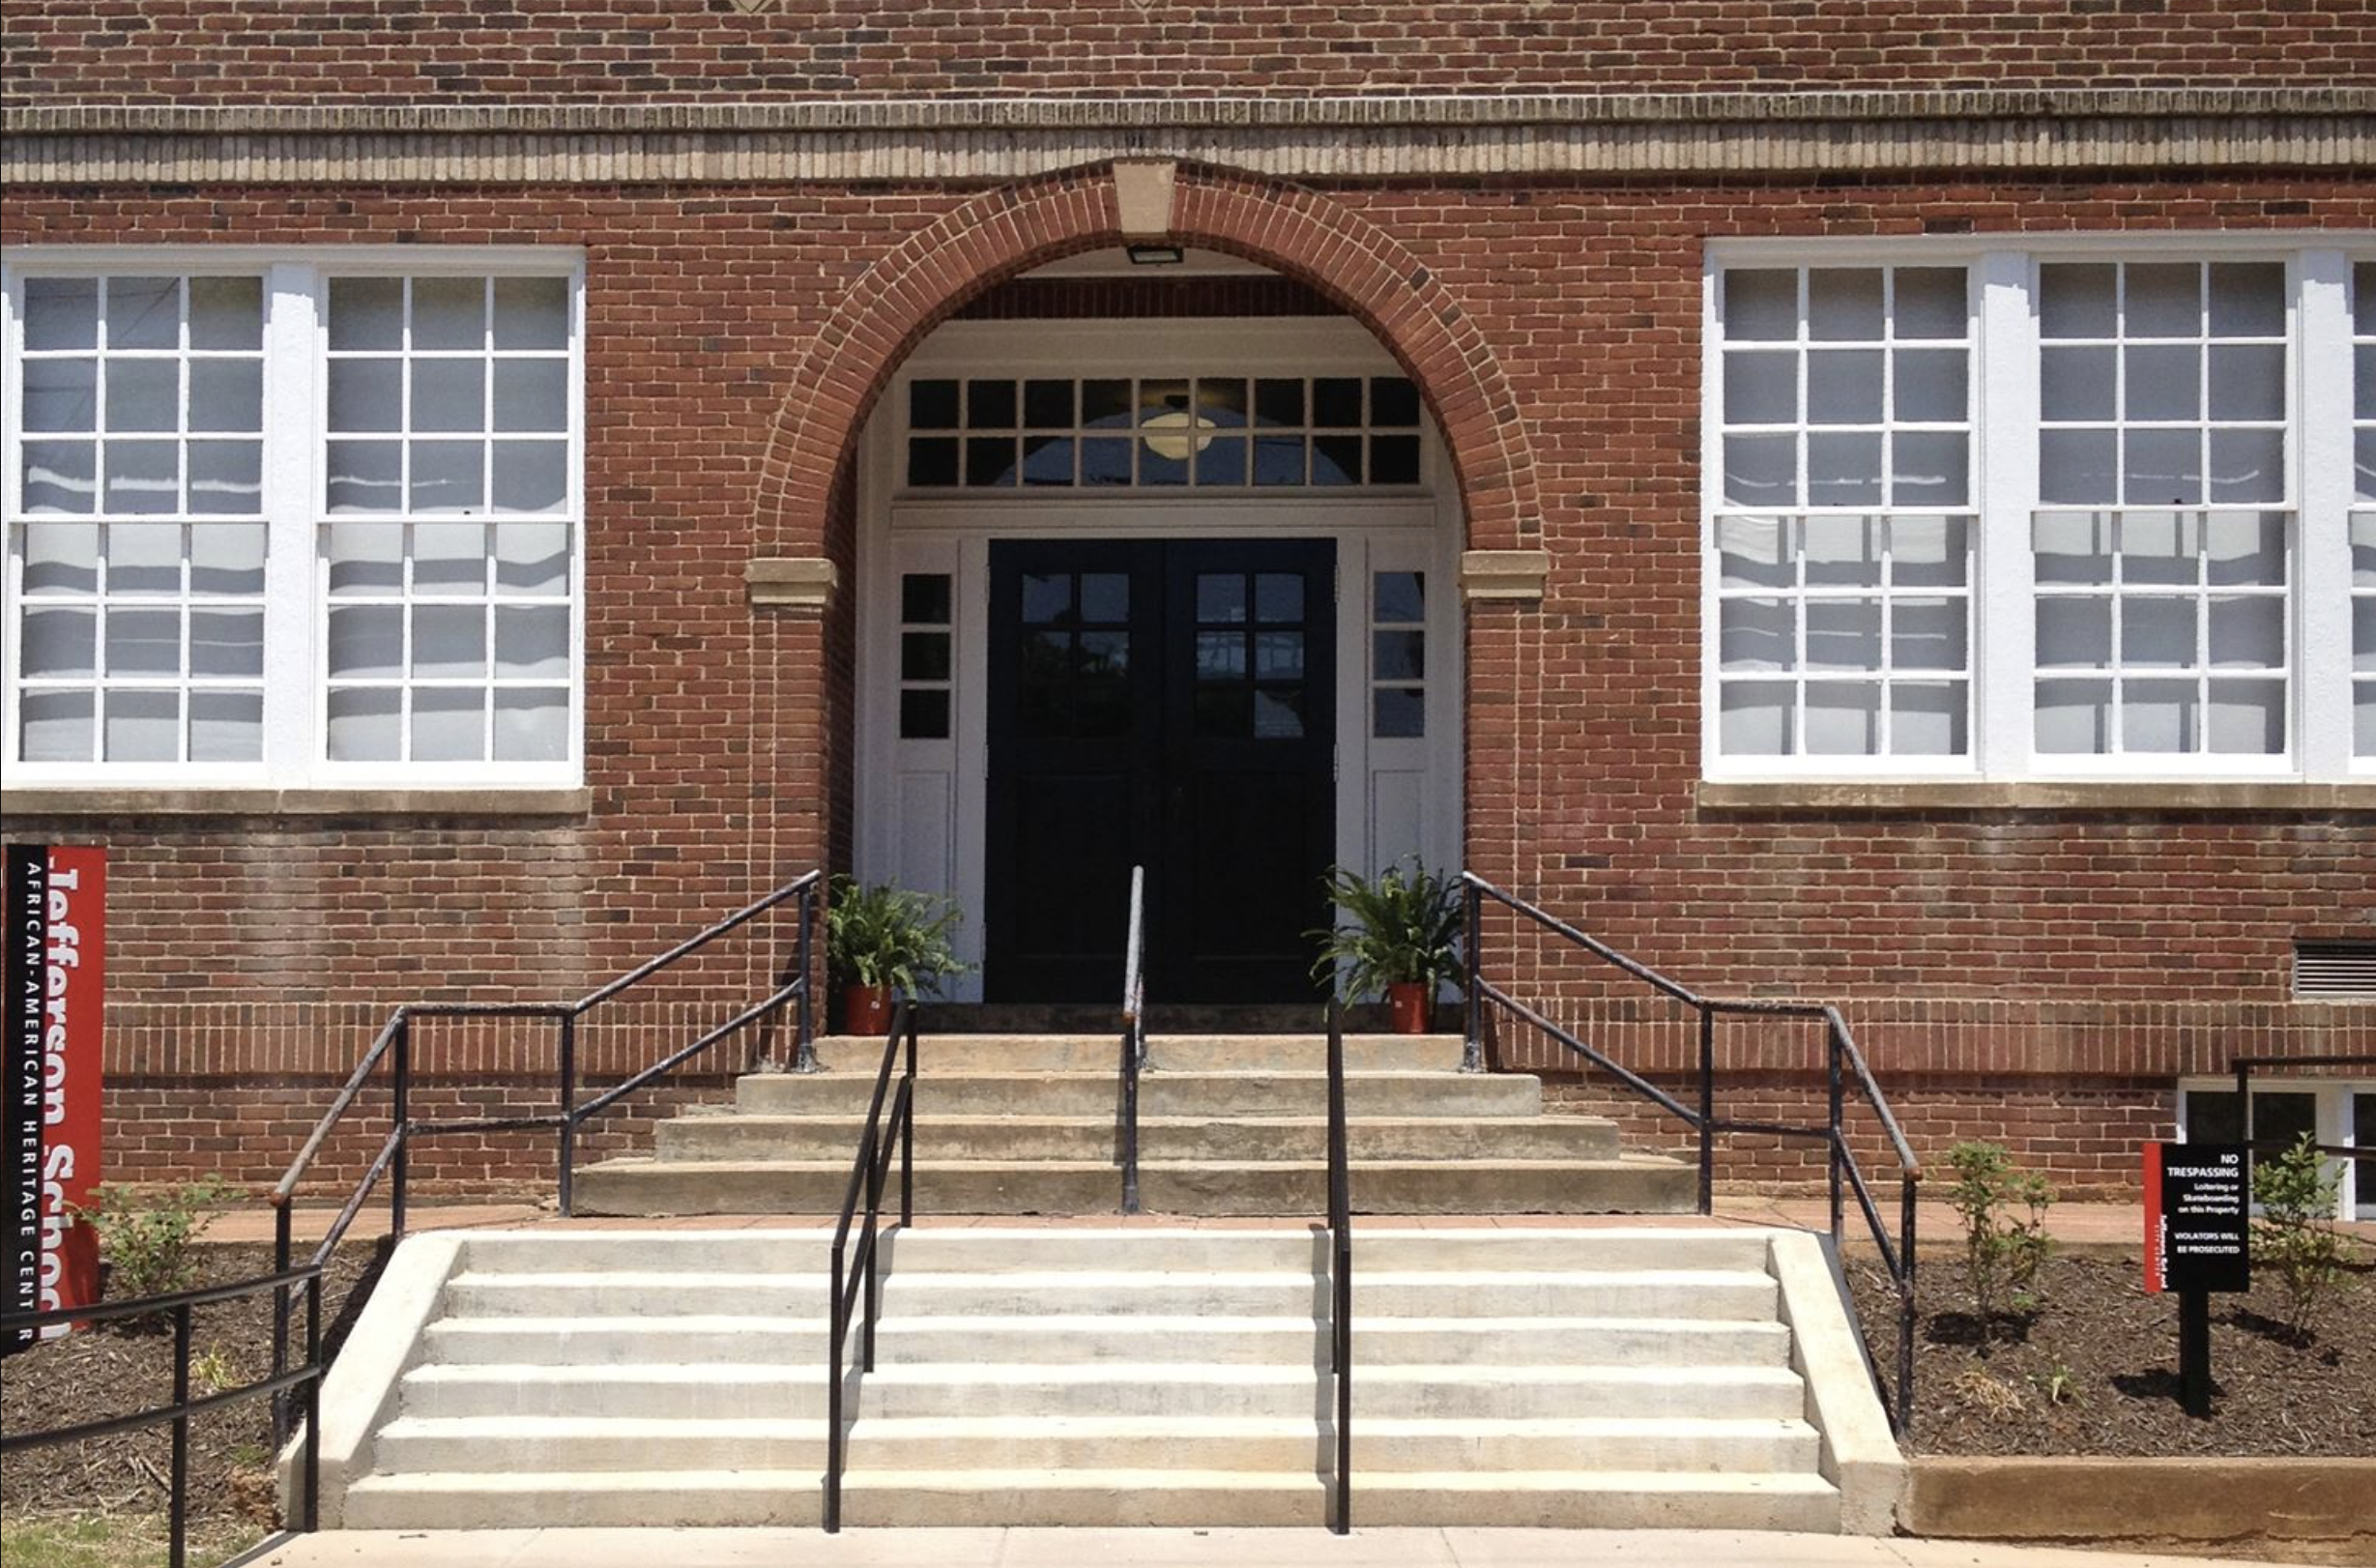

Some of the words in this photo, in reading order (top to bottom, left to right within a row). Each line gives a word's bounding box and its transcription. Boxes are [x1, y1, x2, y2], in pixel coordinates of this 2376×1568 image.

[23, 862, 42, 1105] AFRICAN-AMERICAN
[45, 856, 79, 1124] Jefferson
[2220, 1153, 2239, 1164] NO
[2167, 1167, 2239, 1177] TRESPASSING
[20, 1120, 38, 1236] HERITAGE
[2193, 1183, 2229, 1192] Loitering
[2183, 1194, 2240, 1204] Skateboarding
[2190, 1205, 2204, 1213] this
[2206, 1205, 2240, 1215] Property
[2177, 1245, 2187, 1254] BE
[2188, 1245, 2240, 1254] PROSECUTED
[18, 1251, 35, 1340] CENTR
